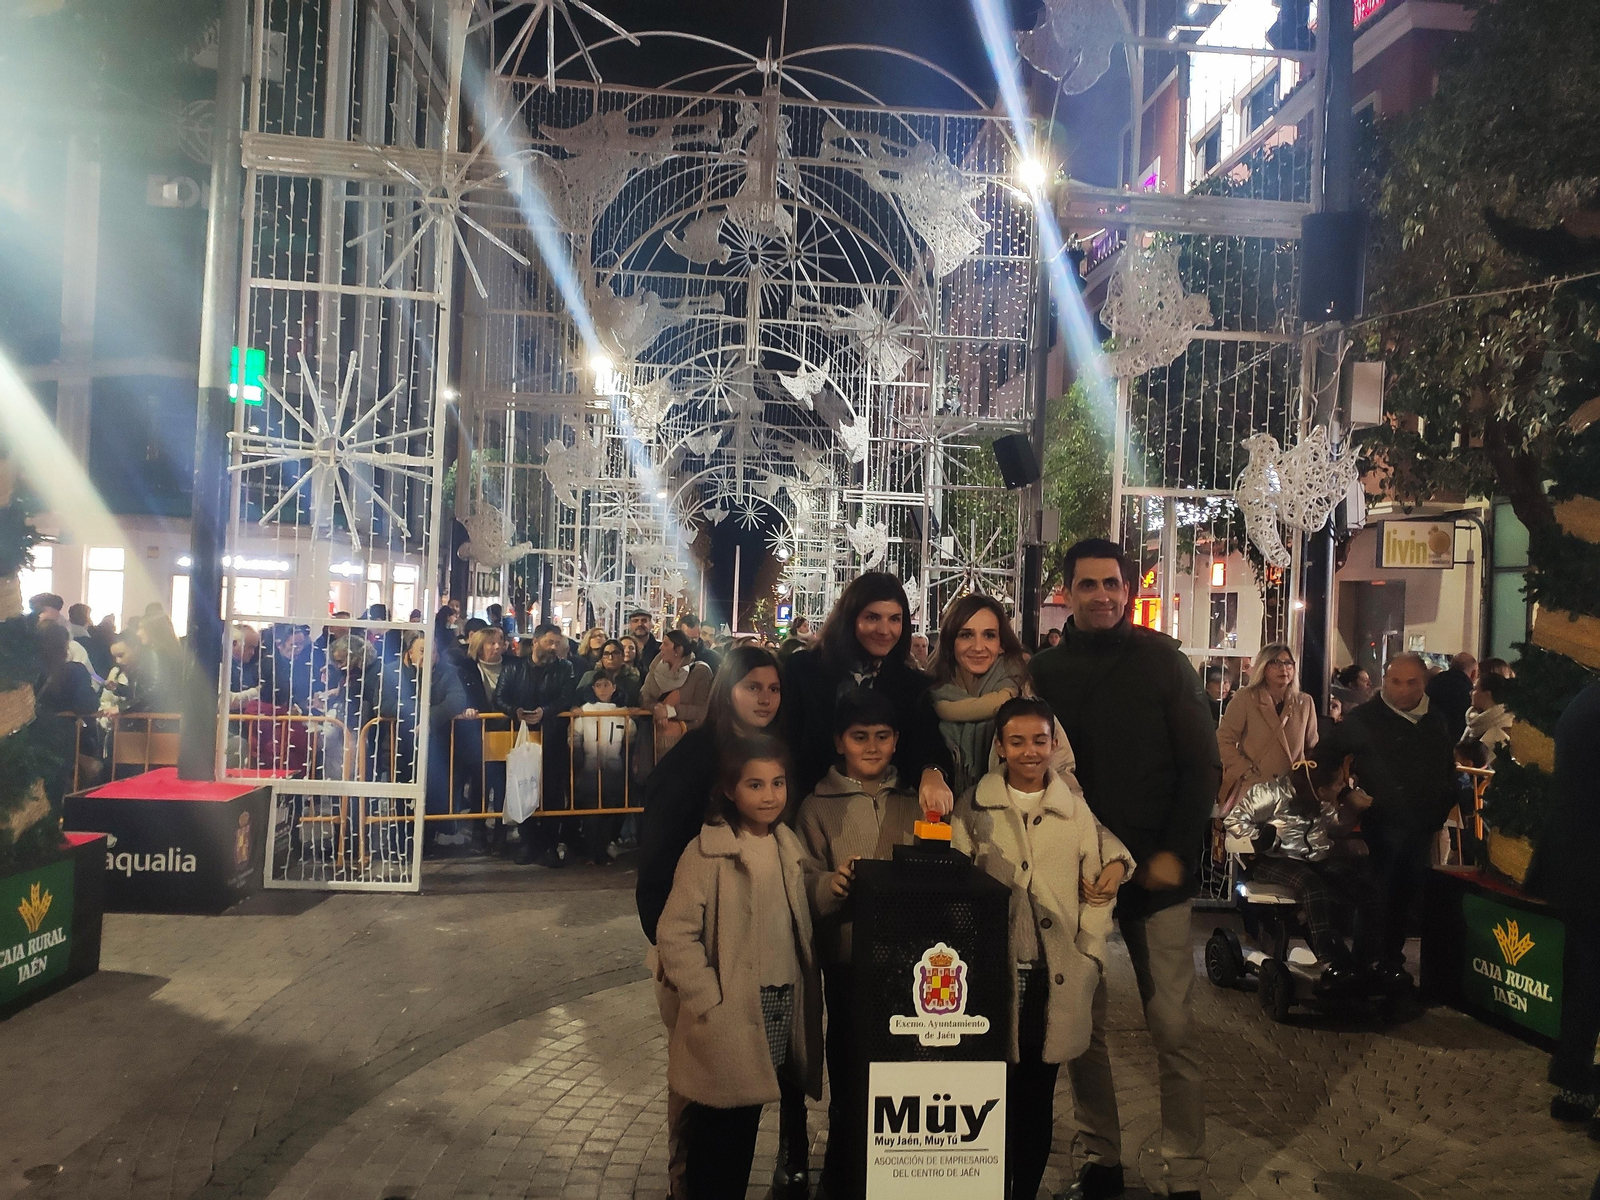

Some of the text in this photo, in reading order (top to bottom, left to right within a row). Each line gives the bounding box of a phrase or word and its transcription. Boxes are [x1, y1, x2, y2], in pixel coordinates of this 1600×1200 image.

[106, 847, 197, 877] aqualia
[27, 927, 66, 956] RURAL
[17, 955, 48, 985] JAÉN
[1472, 957, 1553, 1003] CAJA RURAL
[1492, 985, 1528, 1013] JAÉN
[895, 1019, 986, 1030] Excmo. Ayuntamiento
[924, 1030, 956, 1040] de Jaén
[874, 1093, 1000, 1142] Müy
[875, 1134, 958, 1147] Muy Jaén, Muy Tú
[874, 1155, 999, 1166] ASOCIACIÓN DE EMPRESARIOS
[892, 1166, 980, 1178] DEL CENTRO DE JAÉN
